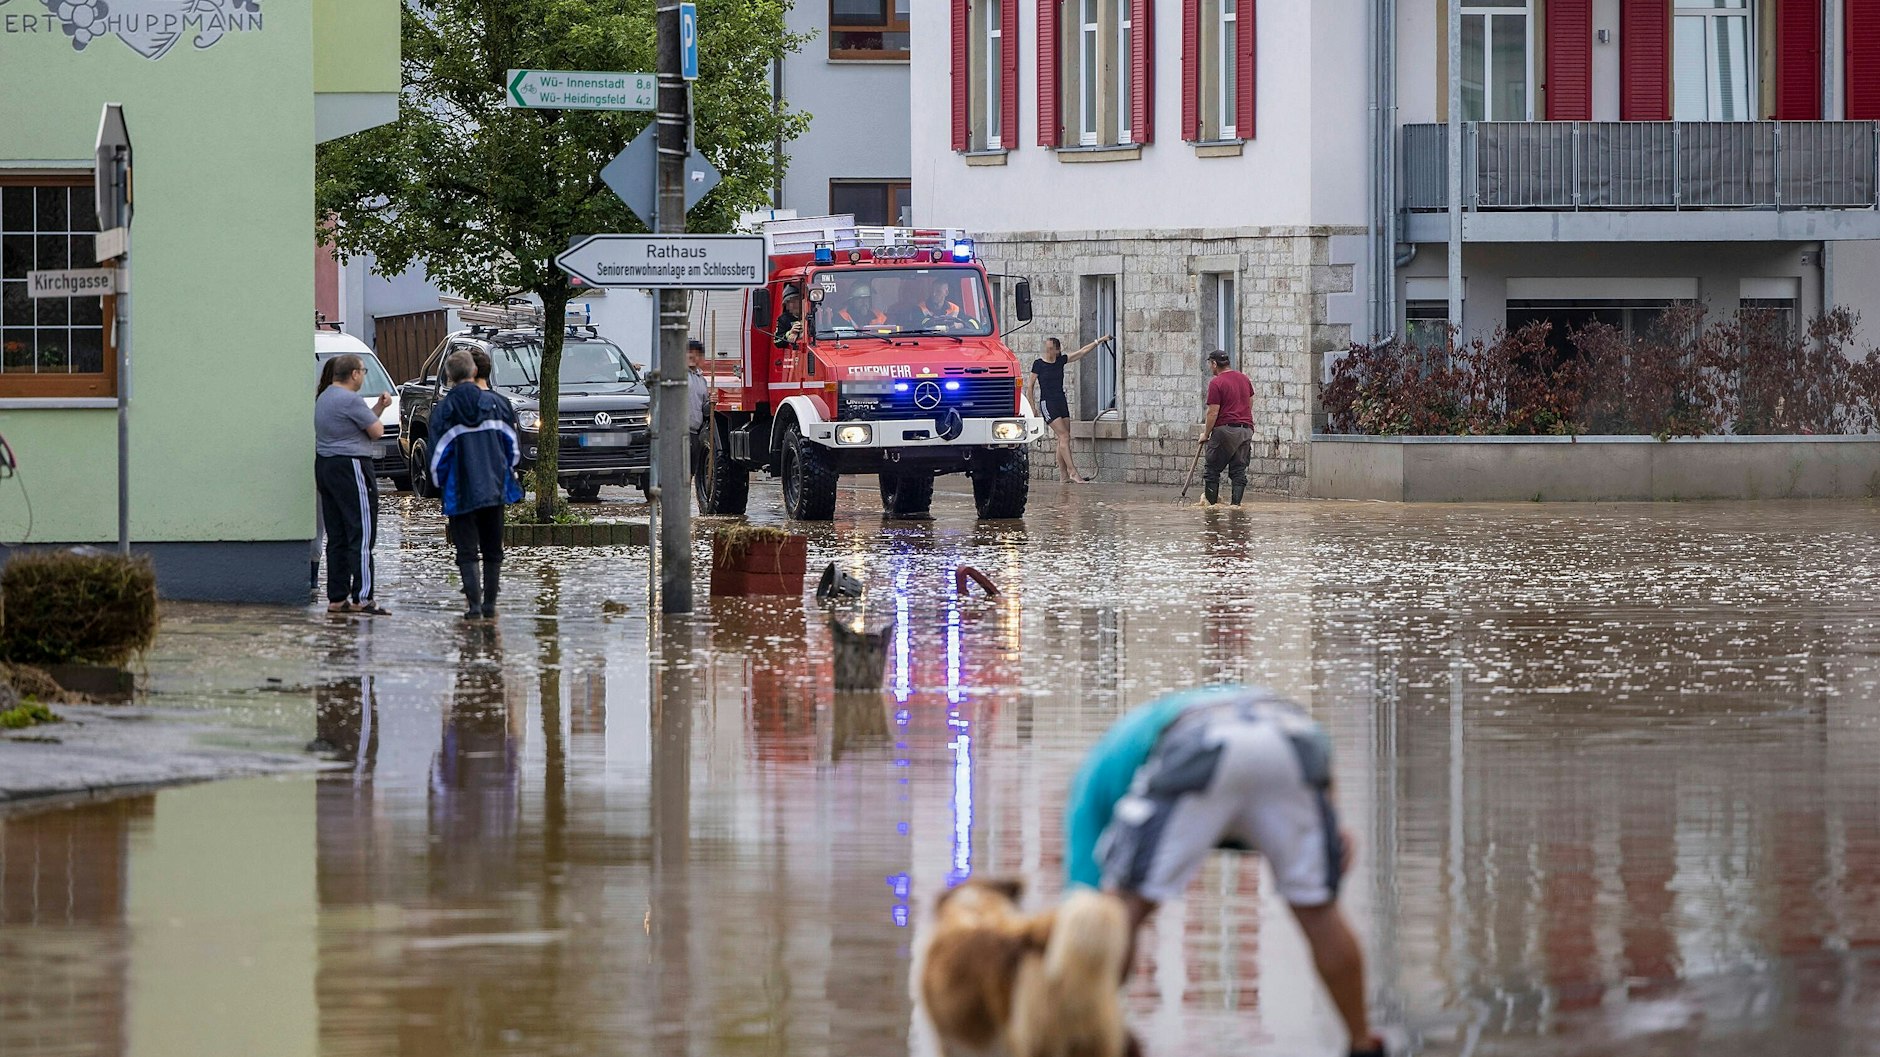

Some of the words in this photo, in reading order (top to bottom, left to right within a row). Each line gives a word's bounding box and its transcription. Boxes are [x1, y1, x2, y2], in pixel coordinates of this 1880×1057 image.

[107, 13, 264, 33] HUPPMANN
[567, 77, 626, 90] Innenstadt
[636, 79, 652, 90] 8,8
[564, 93, 626, 107] Heidingsfeld
[636, 94, 651, 106] 4,2
[646, 244, 707, 258] Rathaus
[597, 262, 686, 279] Seniorenwohnanlage
[688, 265, 701, 277] am
[703, 262, 756, 279] Schlossberg
[34, 273, 109, 293] Kirchgasse
